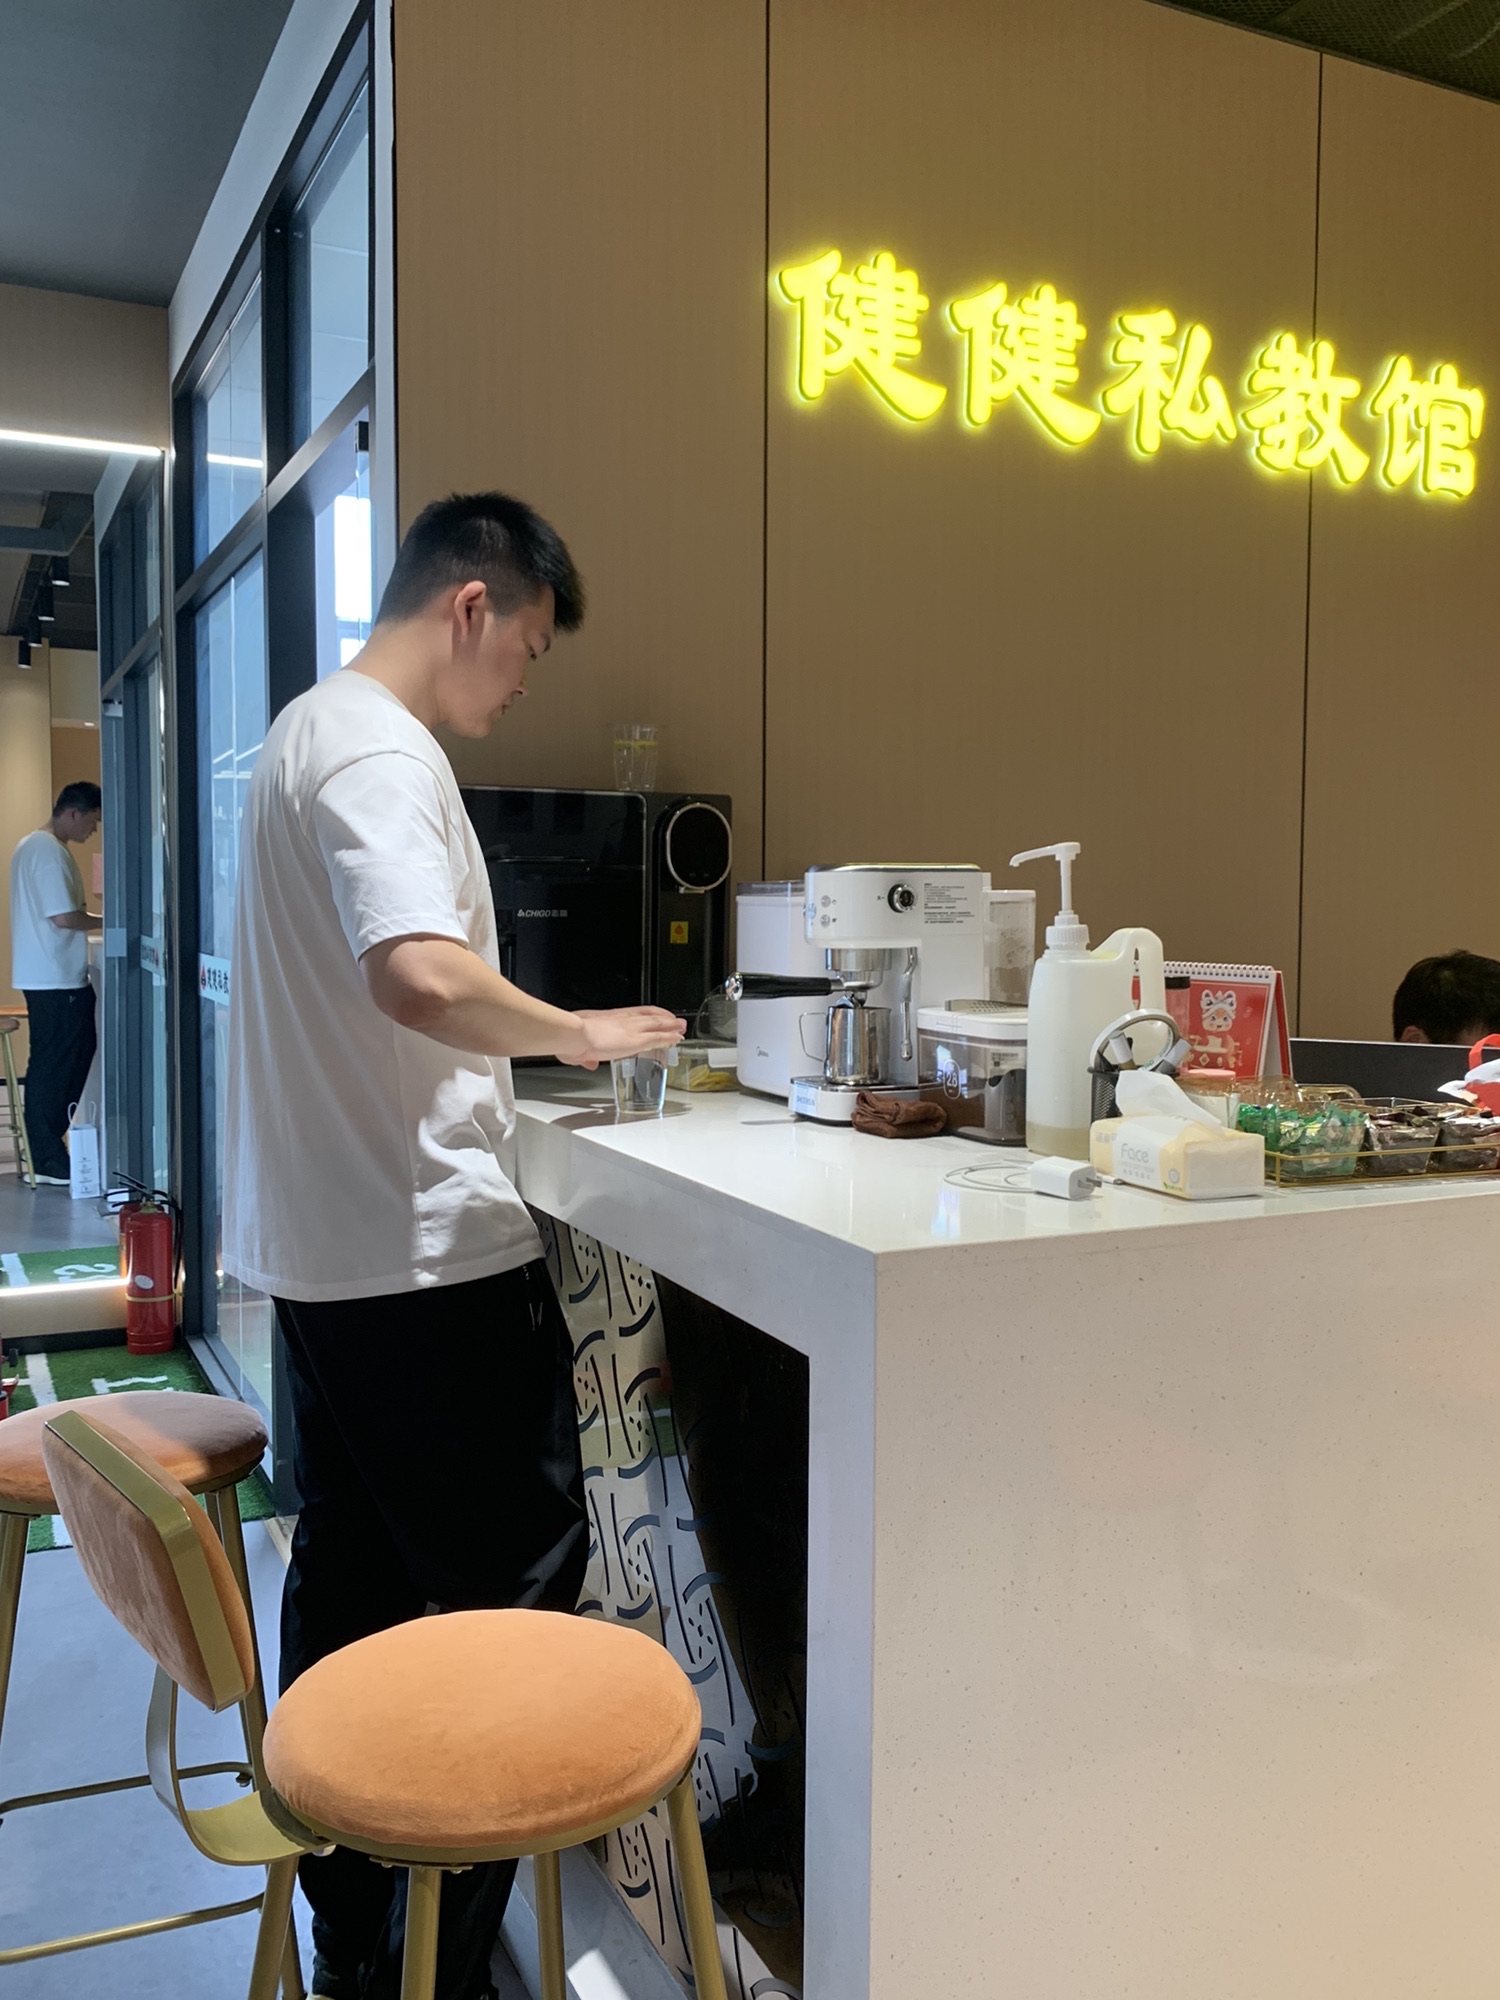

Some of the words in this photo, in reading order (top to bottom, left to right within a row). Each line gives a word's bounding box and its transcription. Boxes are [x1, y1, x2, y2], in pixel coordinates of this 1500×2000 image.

[777, 250, 1485, 498] 健健私教馆
[525, 909, 551, 918] CHIGO
